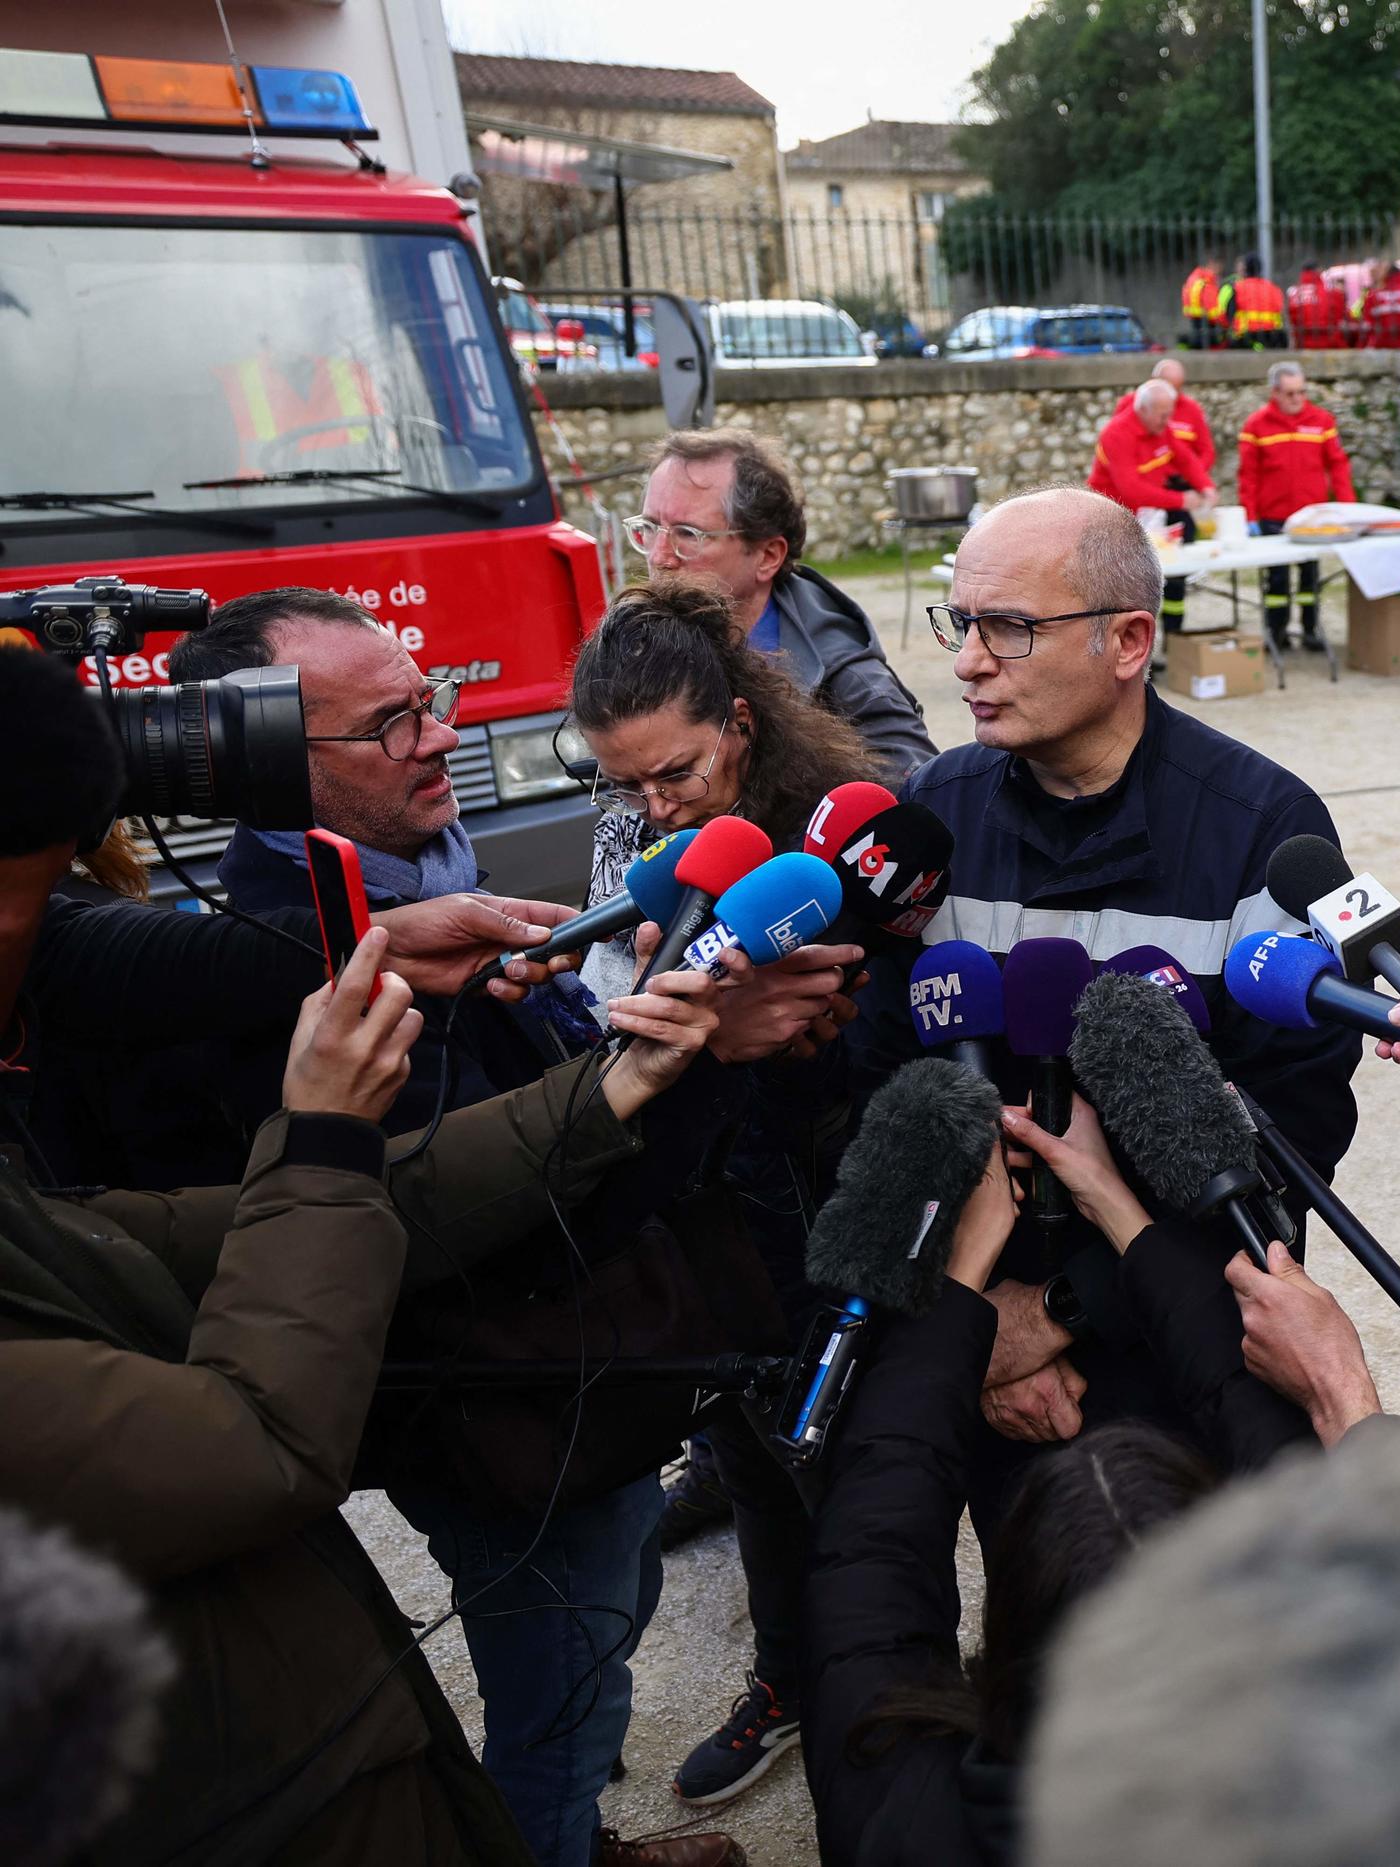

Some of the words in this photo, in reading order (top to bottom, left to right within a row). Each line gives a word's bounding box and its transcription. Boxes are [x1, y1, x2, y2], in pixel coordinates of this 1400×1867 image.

[388, 580, 427, 607] de
[841, 831, 899, 898] M6
[1346, 888, 1382, 918] 2
[1248, 936, 1280, 982] AFP
[910, 973, 962, 1007] BFM
[1149, 968, 1175, 986] CI
[1175, 983, 1188, 993] 26
